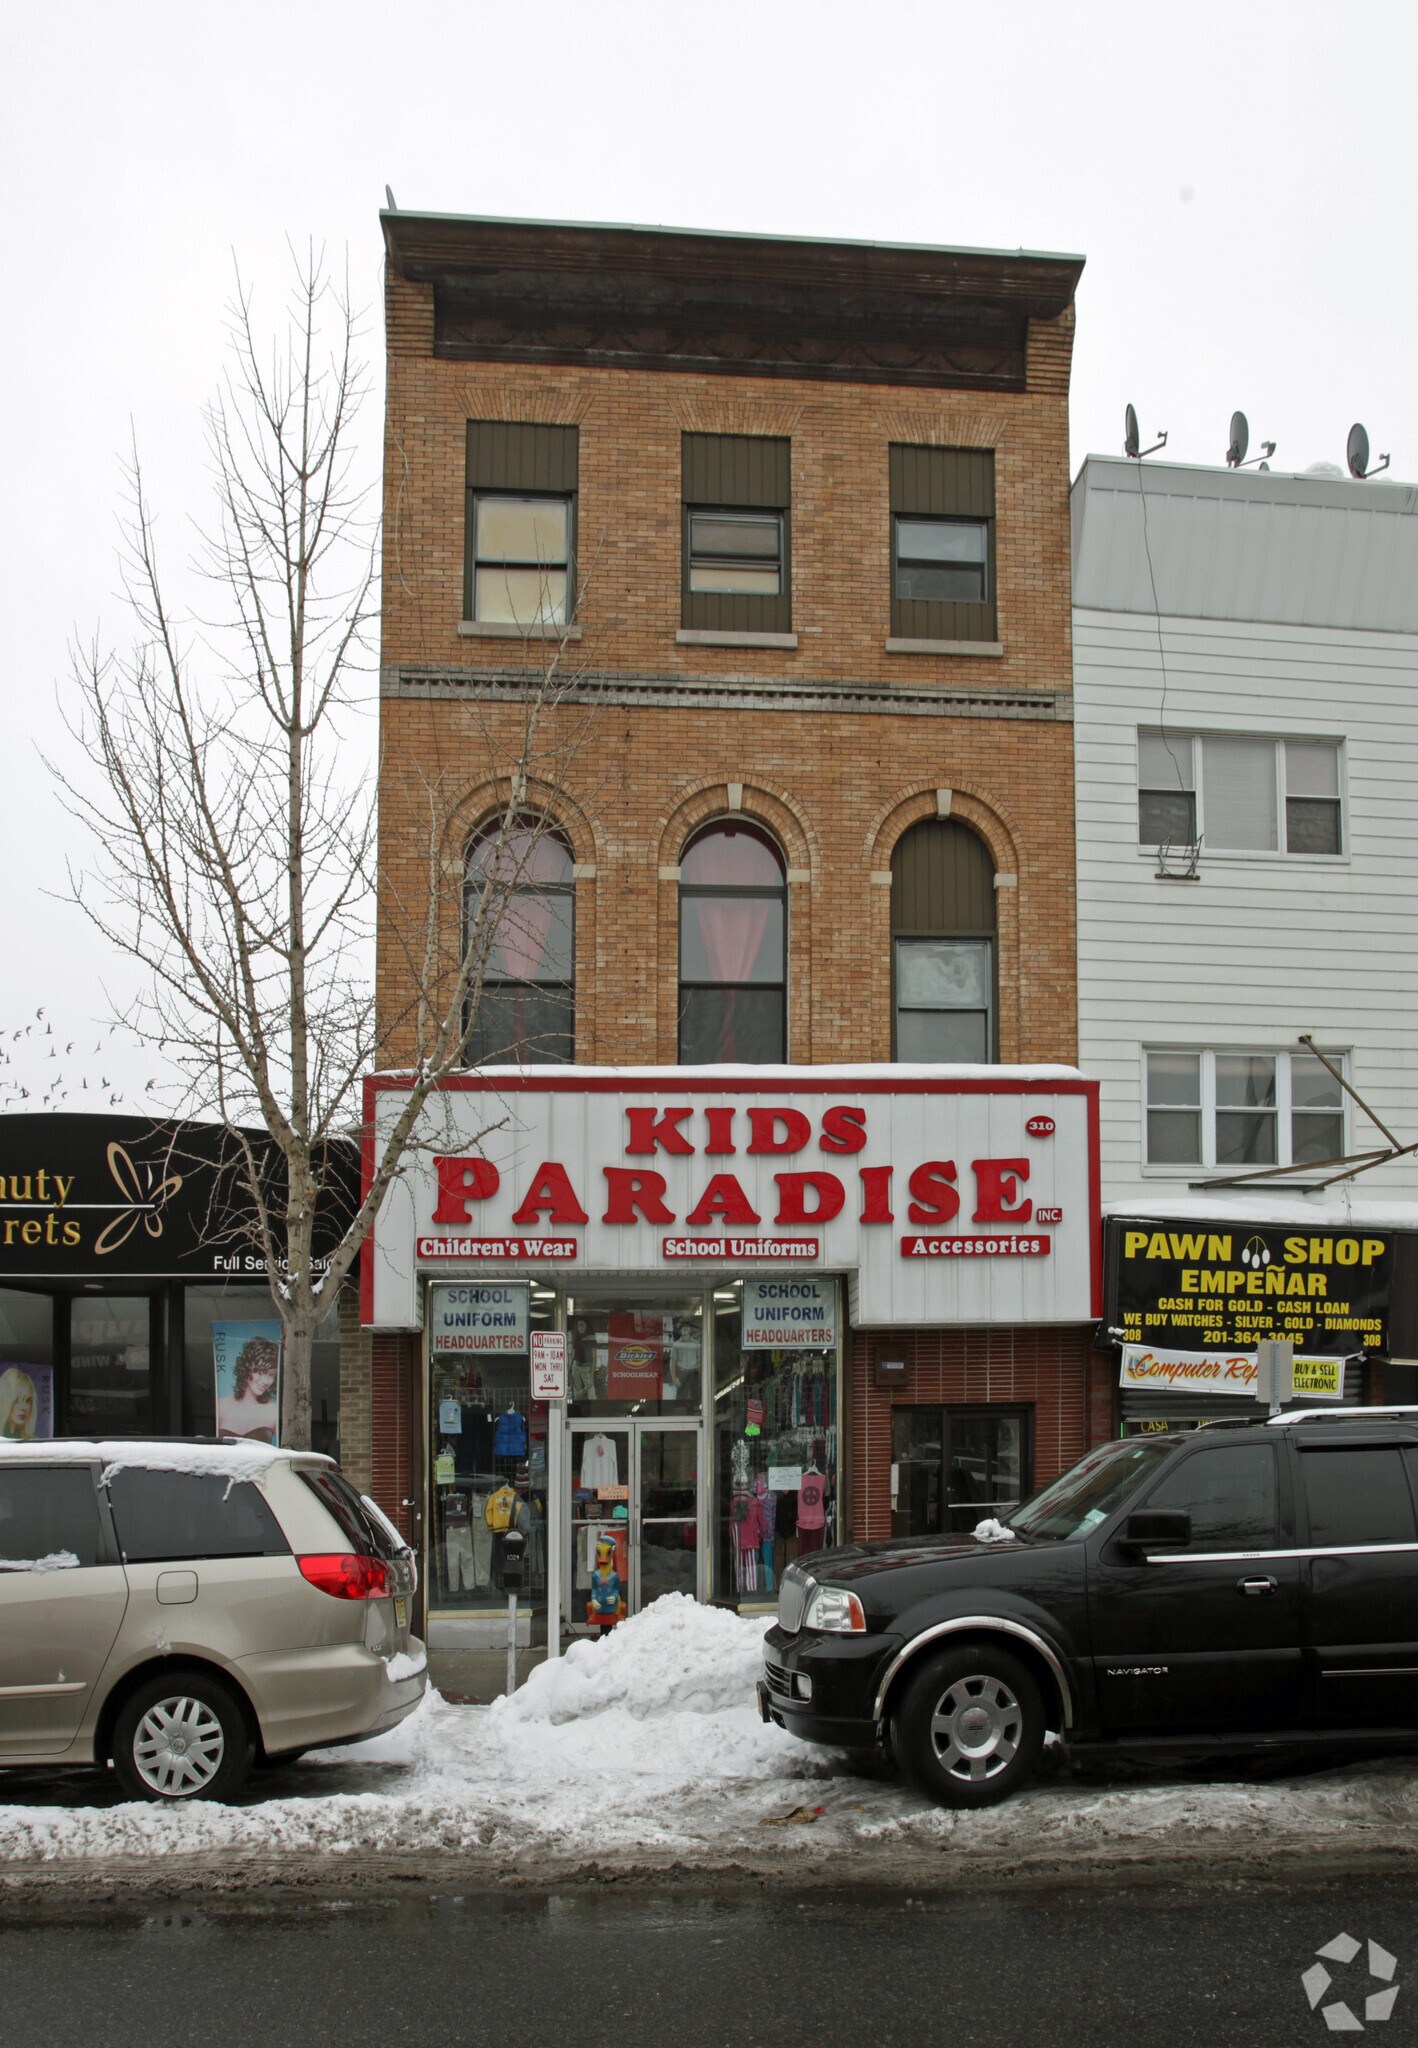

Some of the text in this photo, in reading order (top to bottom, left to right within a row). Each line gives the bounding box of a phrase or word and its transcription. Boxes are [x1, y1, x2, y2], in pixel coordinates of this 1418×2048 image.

[625, 1106, 867, 1154] KIDS
[1028, 1121, 1054, 1131] 310
[432, 1156, 1033, 1224] PARADISE
[1037, 1208, 1061, 1221] INC.
[3, 1212, 81, 1246] rets
[420, 1238, 575, 1257] Children's Wear
[665, 1238, 816, 1257] School Uniforms
[912, 1236, 1040, 1255] Accessories
[1124, 1231, 1385, 1266] PAWN SHOP
[213, 1255, 240, 1270] Full
[1181, 1264, 1328, 1296] EMPEÑAR
[447, 1289, 513, 1304] SCHOOL
[758, 1284, 821, 1299] SCHOOL
[754, 1306, 825, 1321] UNIFORM
[1158, 1297, 1194, 1311] CASH
[1197, 1298, 1224, 1312] FOR
[1228, 1299, 1263, 1313] GOLD
[1276, 1300, 1312, 1314] CASH
[1315, 1301, 1350, 1315] LOAN
[443, 1312, 516, 1327] UNIFORM
[1123, 1312, 1142, 1325] WE
[1145, 1313, 1168, 1326] BUY
[1171, 1314, 1223, 1328] WATCHES
[1235, 1315, 1273, 1329] SILVER
[1284, 1317, 1314, 1330] GOLD
[1324, 1317, 1382, 1331] DIAMONDS
[435, 1335, 524, 1349] HEADQUARTERS
[533, 1334, 563, 1347] NO PARKING
[746, 1328, 833, 1343] HEADQUARTERS
[1123, 1328, 1142, 1341] 308
[1362, 1334, 1381, 1347] 308
[215, 1332, 226, 1373] RUSK
[535, 1362, 563, 1371] MON THRU
[1135, 1353, 1222, 1384] Computer
[1294, 1363, 1335, 1376] BUY & SELL
[543, 1374, 554, 1383] SAT
[1293, 1377, 1336, 1390] ELECTRONIC
[41, 1375, 51, 1415] RUSK
[1140, 1419, 1169, 1432] CASA
[1106, 1666, 1169, 1676] NAVIGATOR
